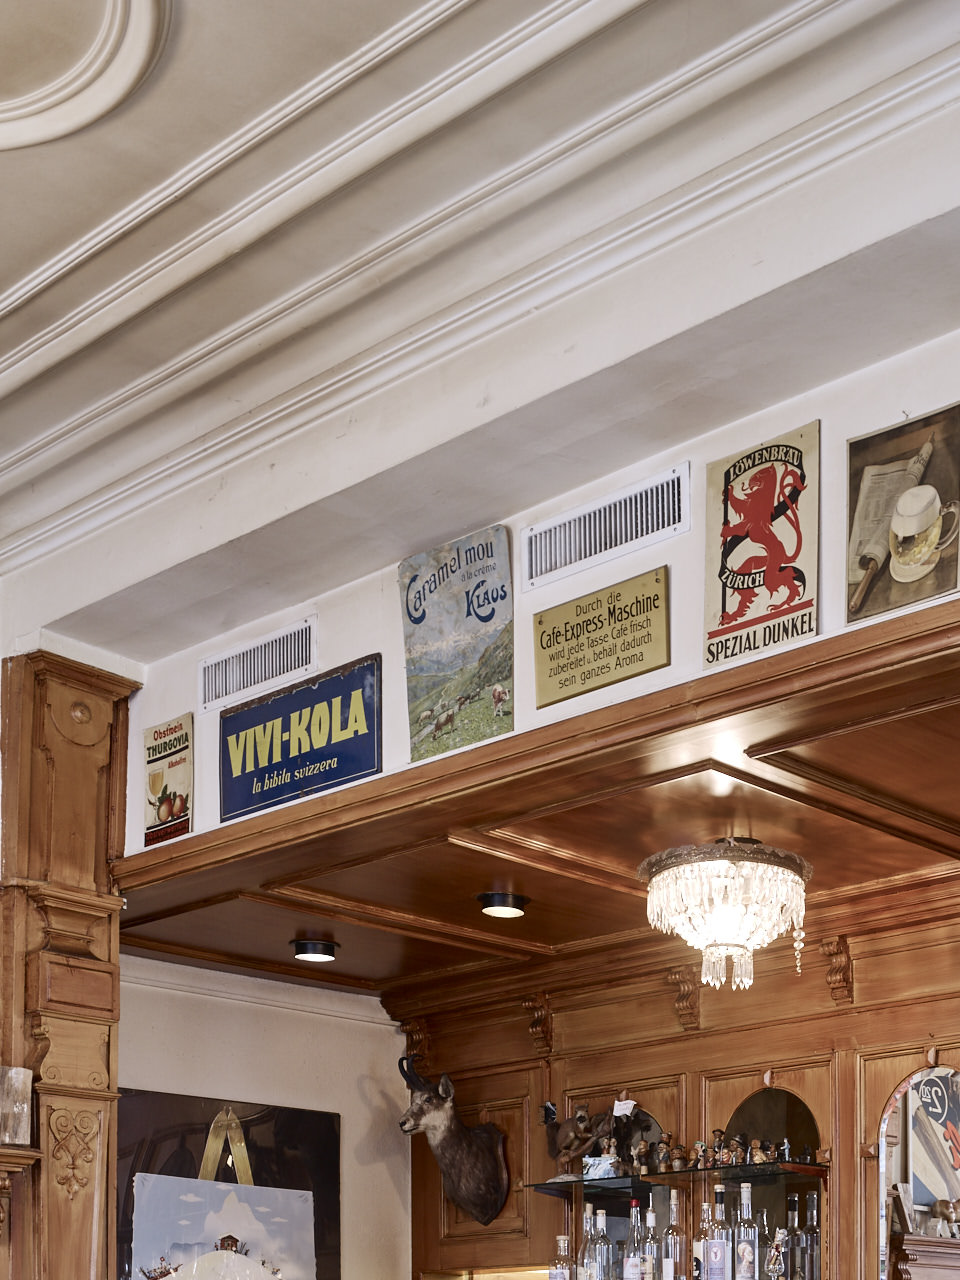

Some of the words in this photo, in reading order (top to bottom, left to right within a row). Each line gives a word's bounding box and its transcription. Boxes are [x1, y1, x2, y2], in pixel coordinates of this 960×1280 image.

[729, 446, 801, 483] LÖWENBRÄU
[406, 546, 461, 625] Caramel
[465, 541, 494, 565] mou
[721, 568, 765, 590] ZÜRICH
[465, 580, 508, 623] KLAUS
[540, 593, 660, 650] Café-Express-Maschine
[575, 597, 602, 617] Durch
[607, 592, 622, 605] die
[548, 655, 585, 678] zubereitet
[620, 632, 652, 653] dadurch
[549, 646, 565, 662] wird
[567, 642, 584, 660] jede
[586, 633, 609, 649] Tasse
[611, 623, 628, 640] Café
[630, 616, 652, 634] frisch
[706, 629, 760, 664] SPEZIAL
[762, 611, 814, 647] DUNKEL
[558, 674, 576, 689] sein
[580, 662, 611, 685] ganzes
[614, 651, 644, 671] Aroma
[147, 732, 189, 758] THURGOVIA
[227, 688, 369, 778] VIVI-KOLA
[252, 777, 262, 794] la
[294, 757, 338, 780] svizzera
